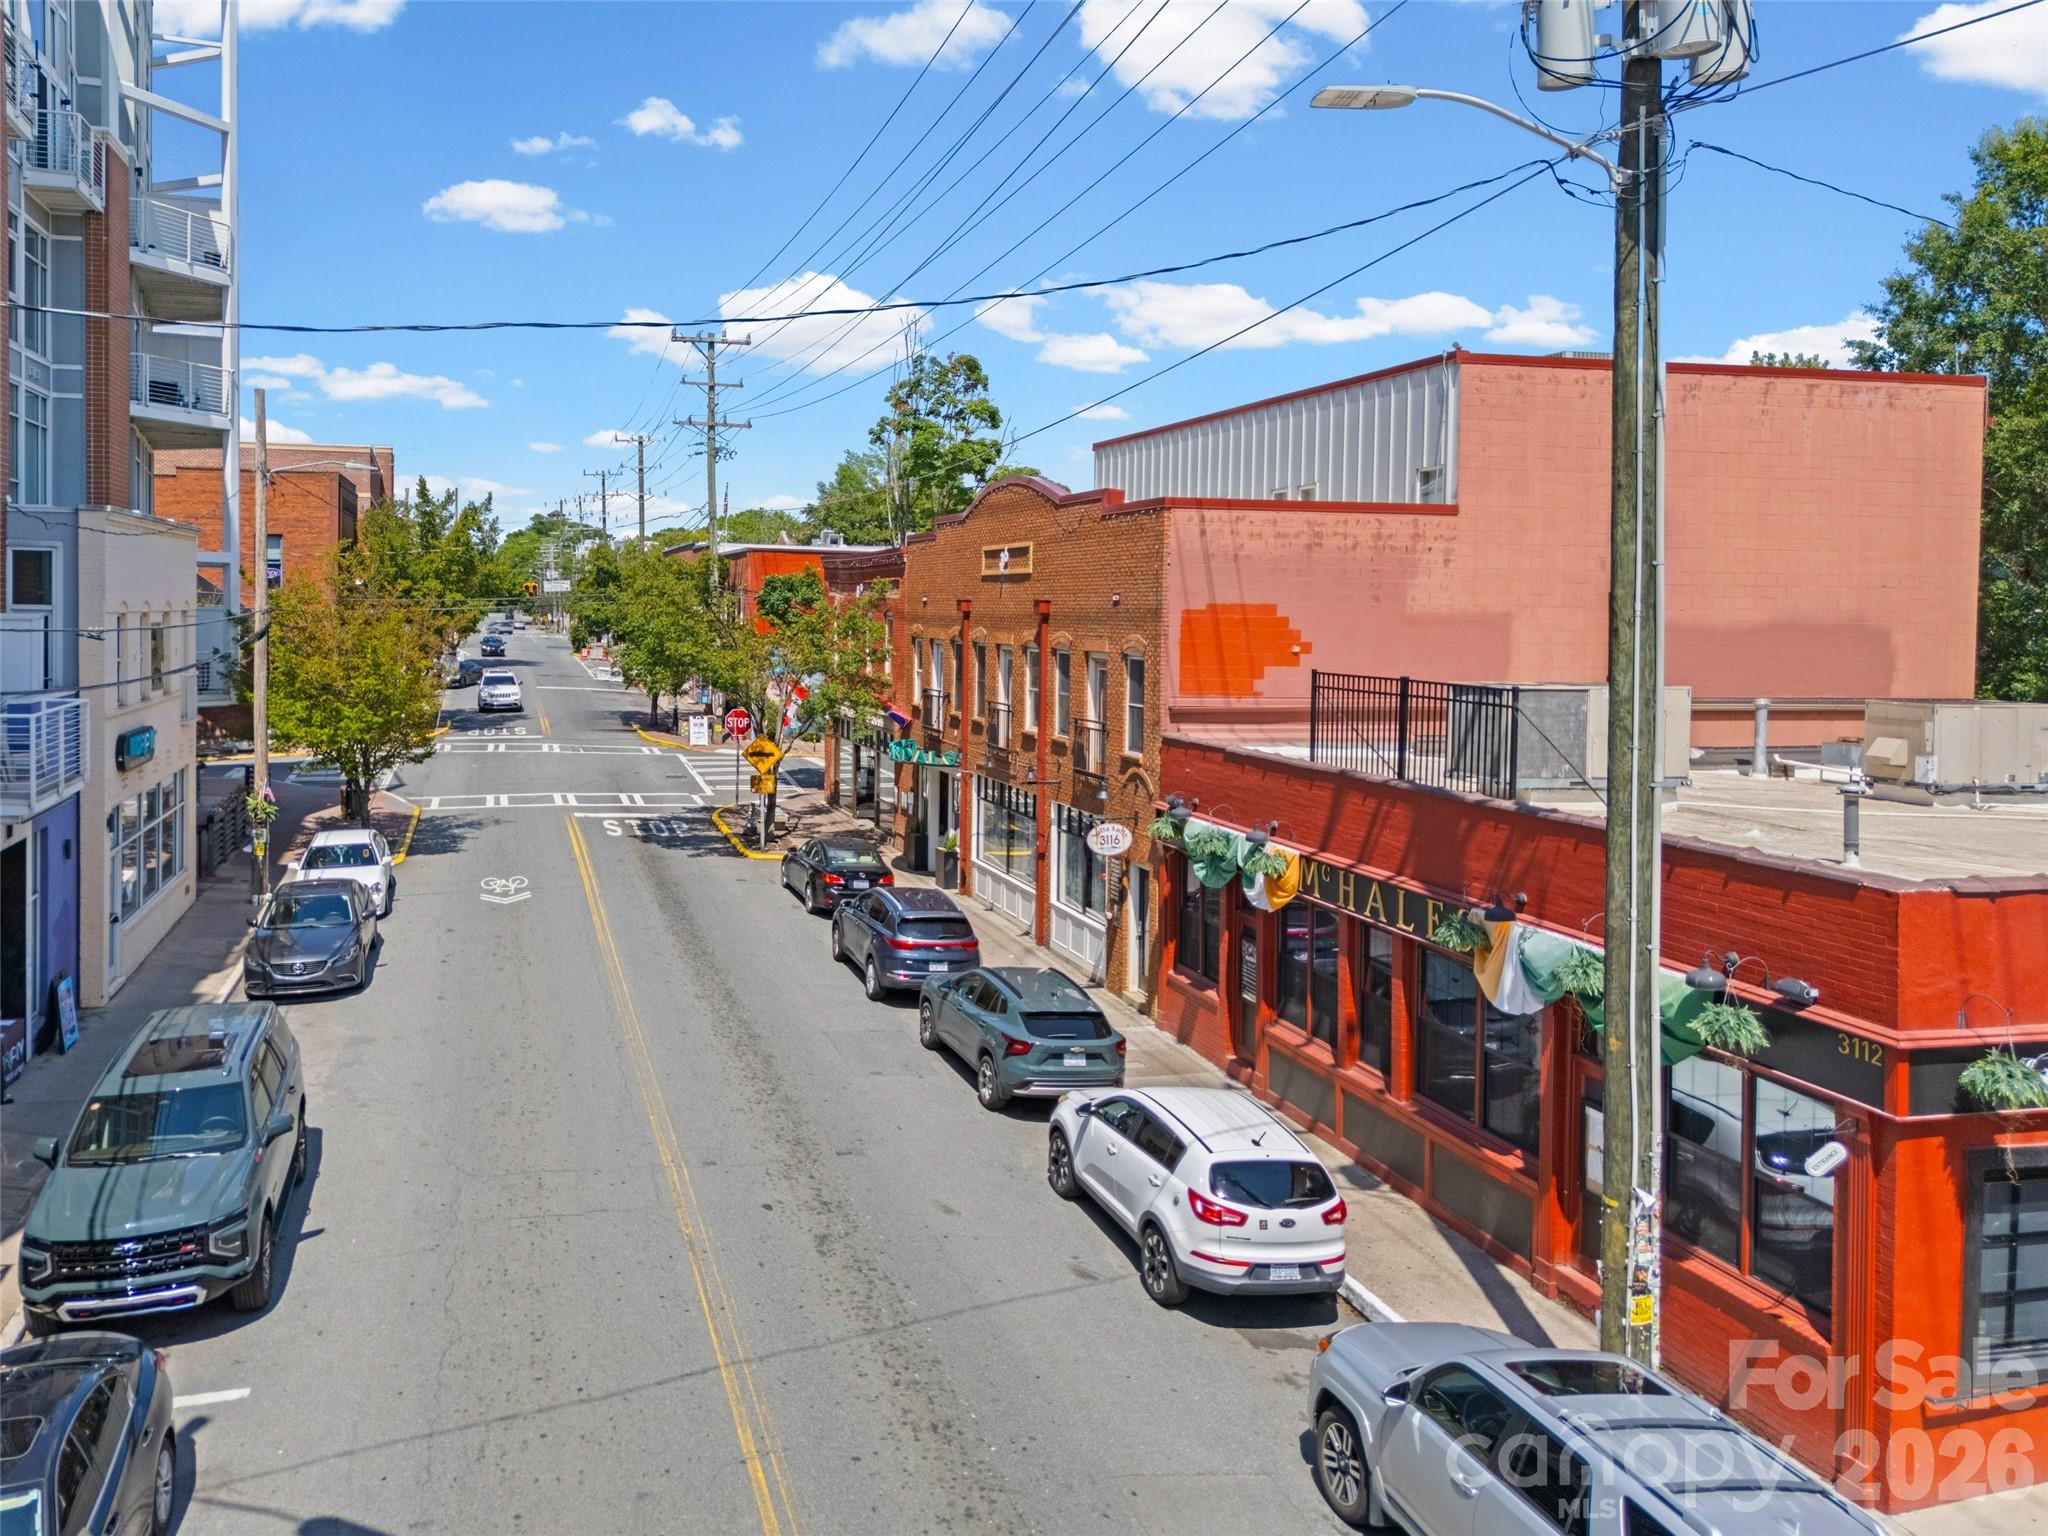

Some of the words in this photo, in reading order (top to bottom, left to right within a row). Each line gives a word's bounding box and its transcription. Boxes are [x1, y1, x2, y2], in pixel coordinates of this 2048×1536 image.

[727, 717, 750, 728] STOP
[468, 727, 527, 736] STOP
[602, 819, 690, 837] STOP
[1100, 834, 1120, 846] 3116
[1838, 1032, 1883, 1066] 3112
